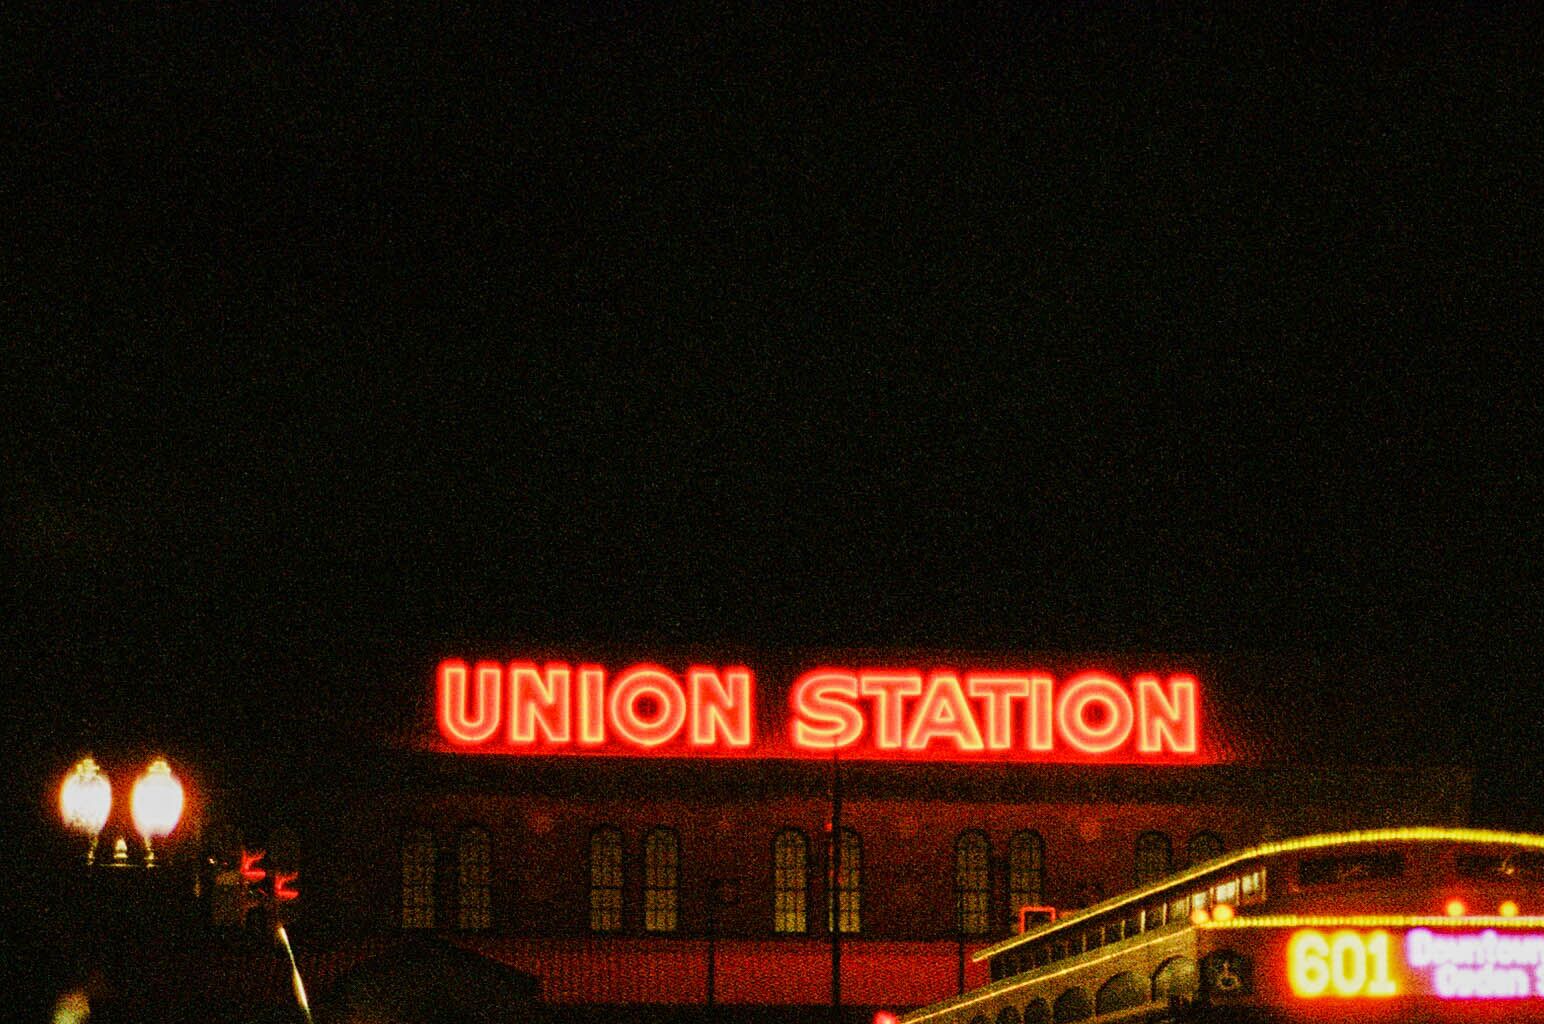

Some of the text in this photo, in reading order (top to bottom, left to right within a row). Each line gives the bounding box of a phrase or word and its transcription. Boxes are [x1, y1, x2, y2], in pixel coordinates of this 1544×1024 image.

[438, 661, 1200, 757] UNION STATION
[1288, 929, 1397, 997] 601
